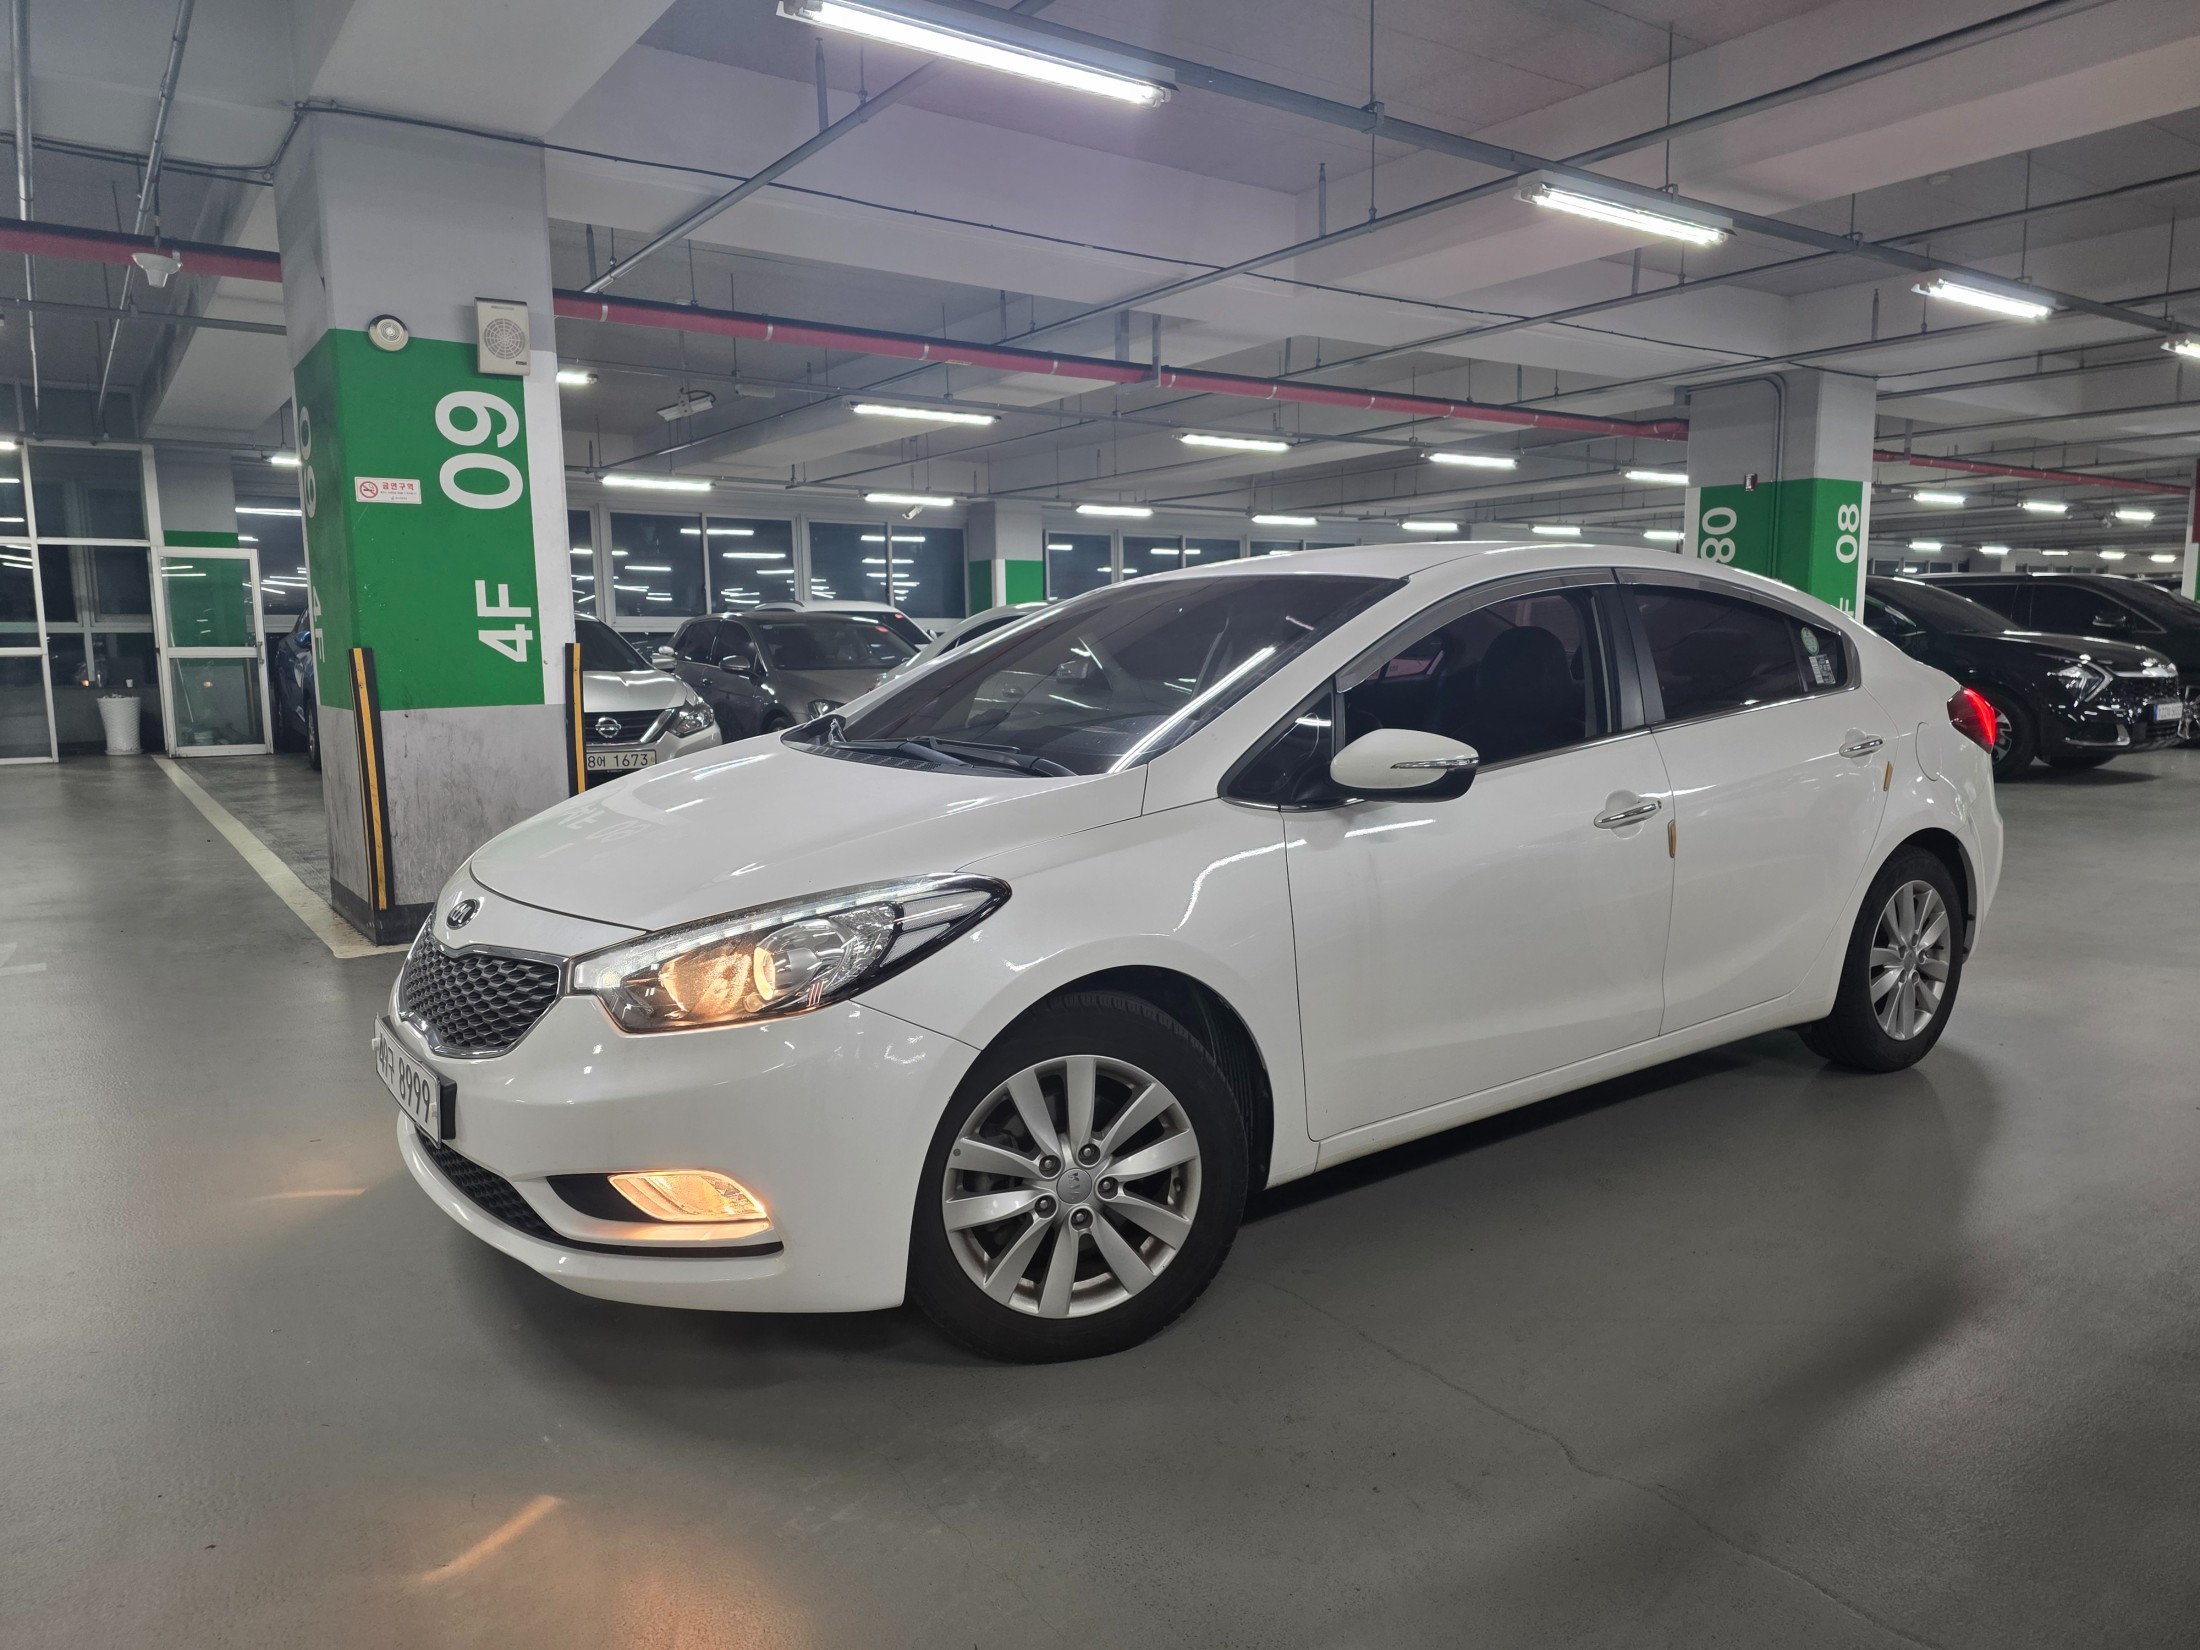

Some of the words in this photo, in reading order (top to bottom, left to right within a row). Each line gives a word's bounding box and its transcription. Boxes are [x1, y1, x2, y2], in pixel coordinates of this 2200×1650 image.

[434, 390, 524, 510] 09
[382, 482, 414, 491] 금연구역
[1835, 503, 1860, 564] 08
[474, 579, 533, 663] 4F
[1839, 597, 1854, 617] F
[587, 755, 606, 769] 8어
[613, 753, 648, 768] 1673
[398, 1056, 431, 1124] 8999
